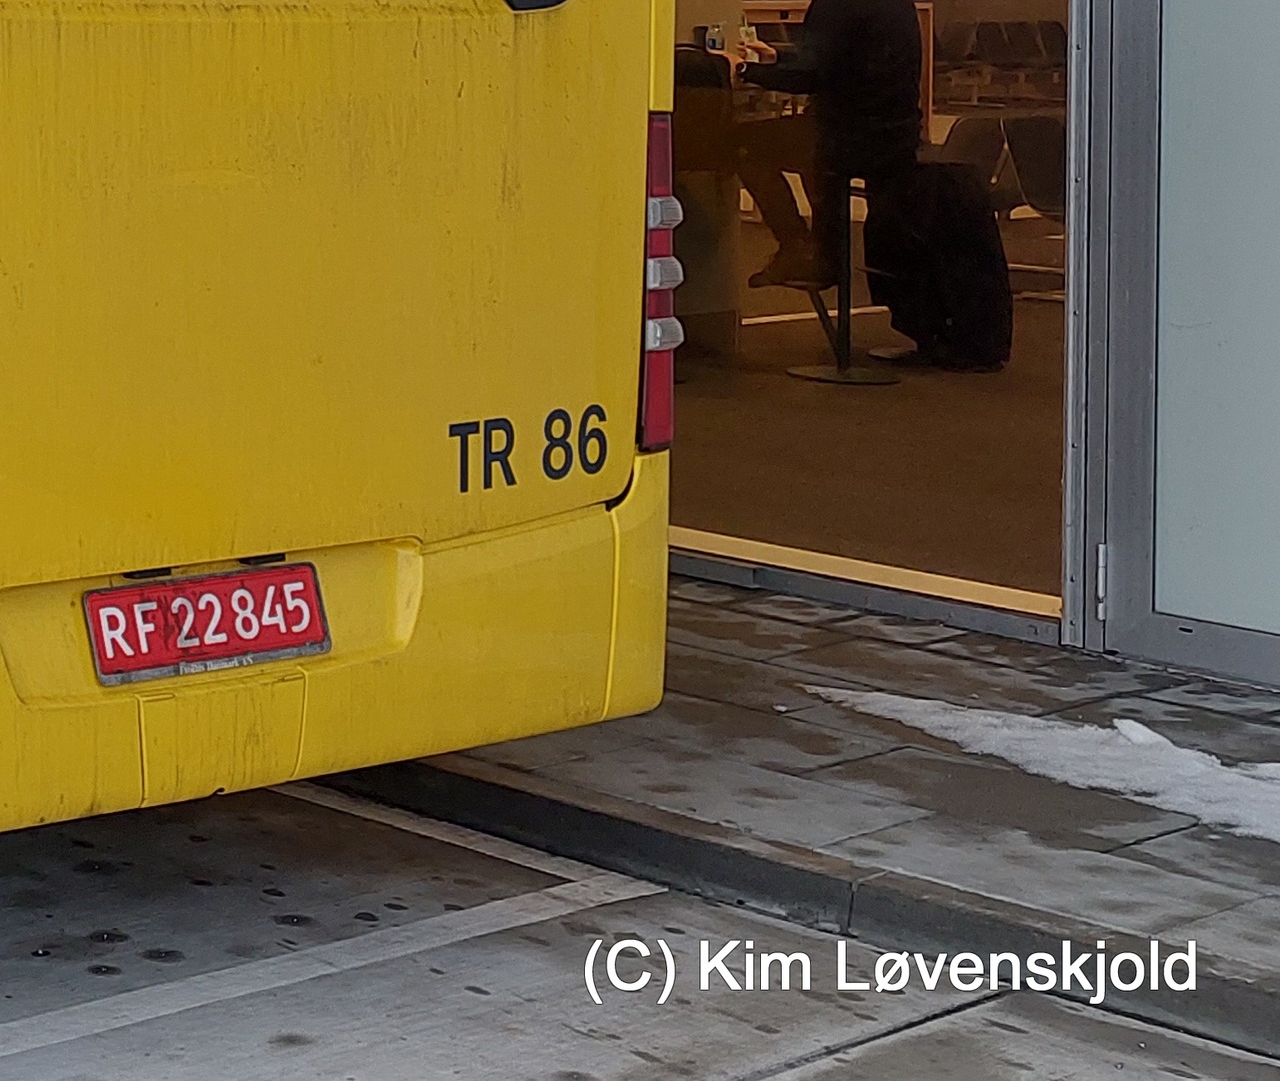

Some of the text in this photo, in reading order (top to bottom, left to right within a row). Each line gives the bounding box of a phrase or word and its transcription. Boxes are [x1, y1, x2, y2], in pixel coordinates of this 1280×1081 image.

[448, 404, 608, 493] TR 86
[98, 601, 158, 659] RF
